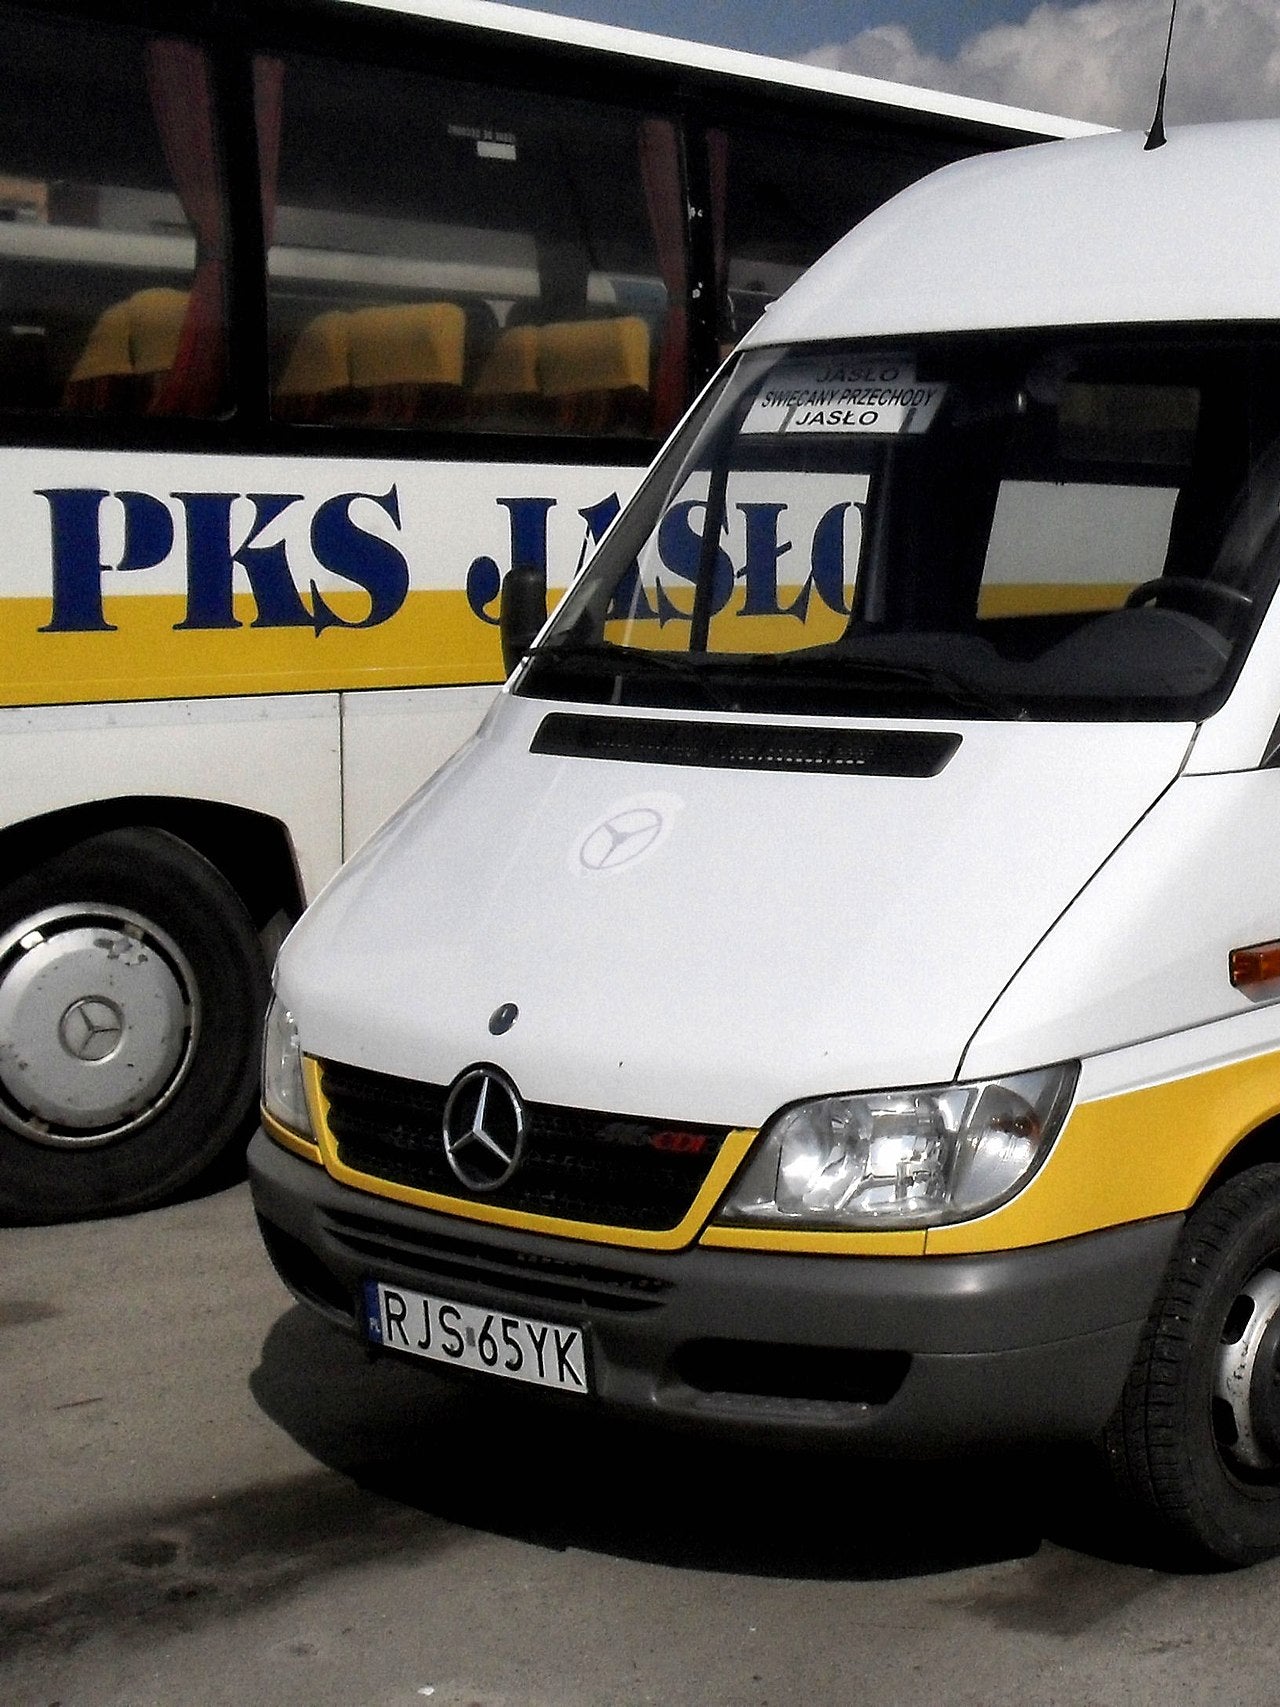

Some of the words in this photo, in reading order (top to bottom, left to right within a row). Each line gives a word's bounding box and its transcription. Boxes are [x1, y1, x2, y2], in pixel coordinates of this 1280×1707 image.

[816, 365, 900, 383] JASŁO
[838, 387, 939, 408] PRZECHODY
[796, 409, 879, 426] JASŁO
[34, 483, 410, 638] PKS
[383, 1290, 465, 1358] RJS
[477, 1314, 583, 1386] 65YK
